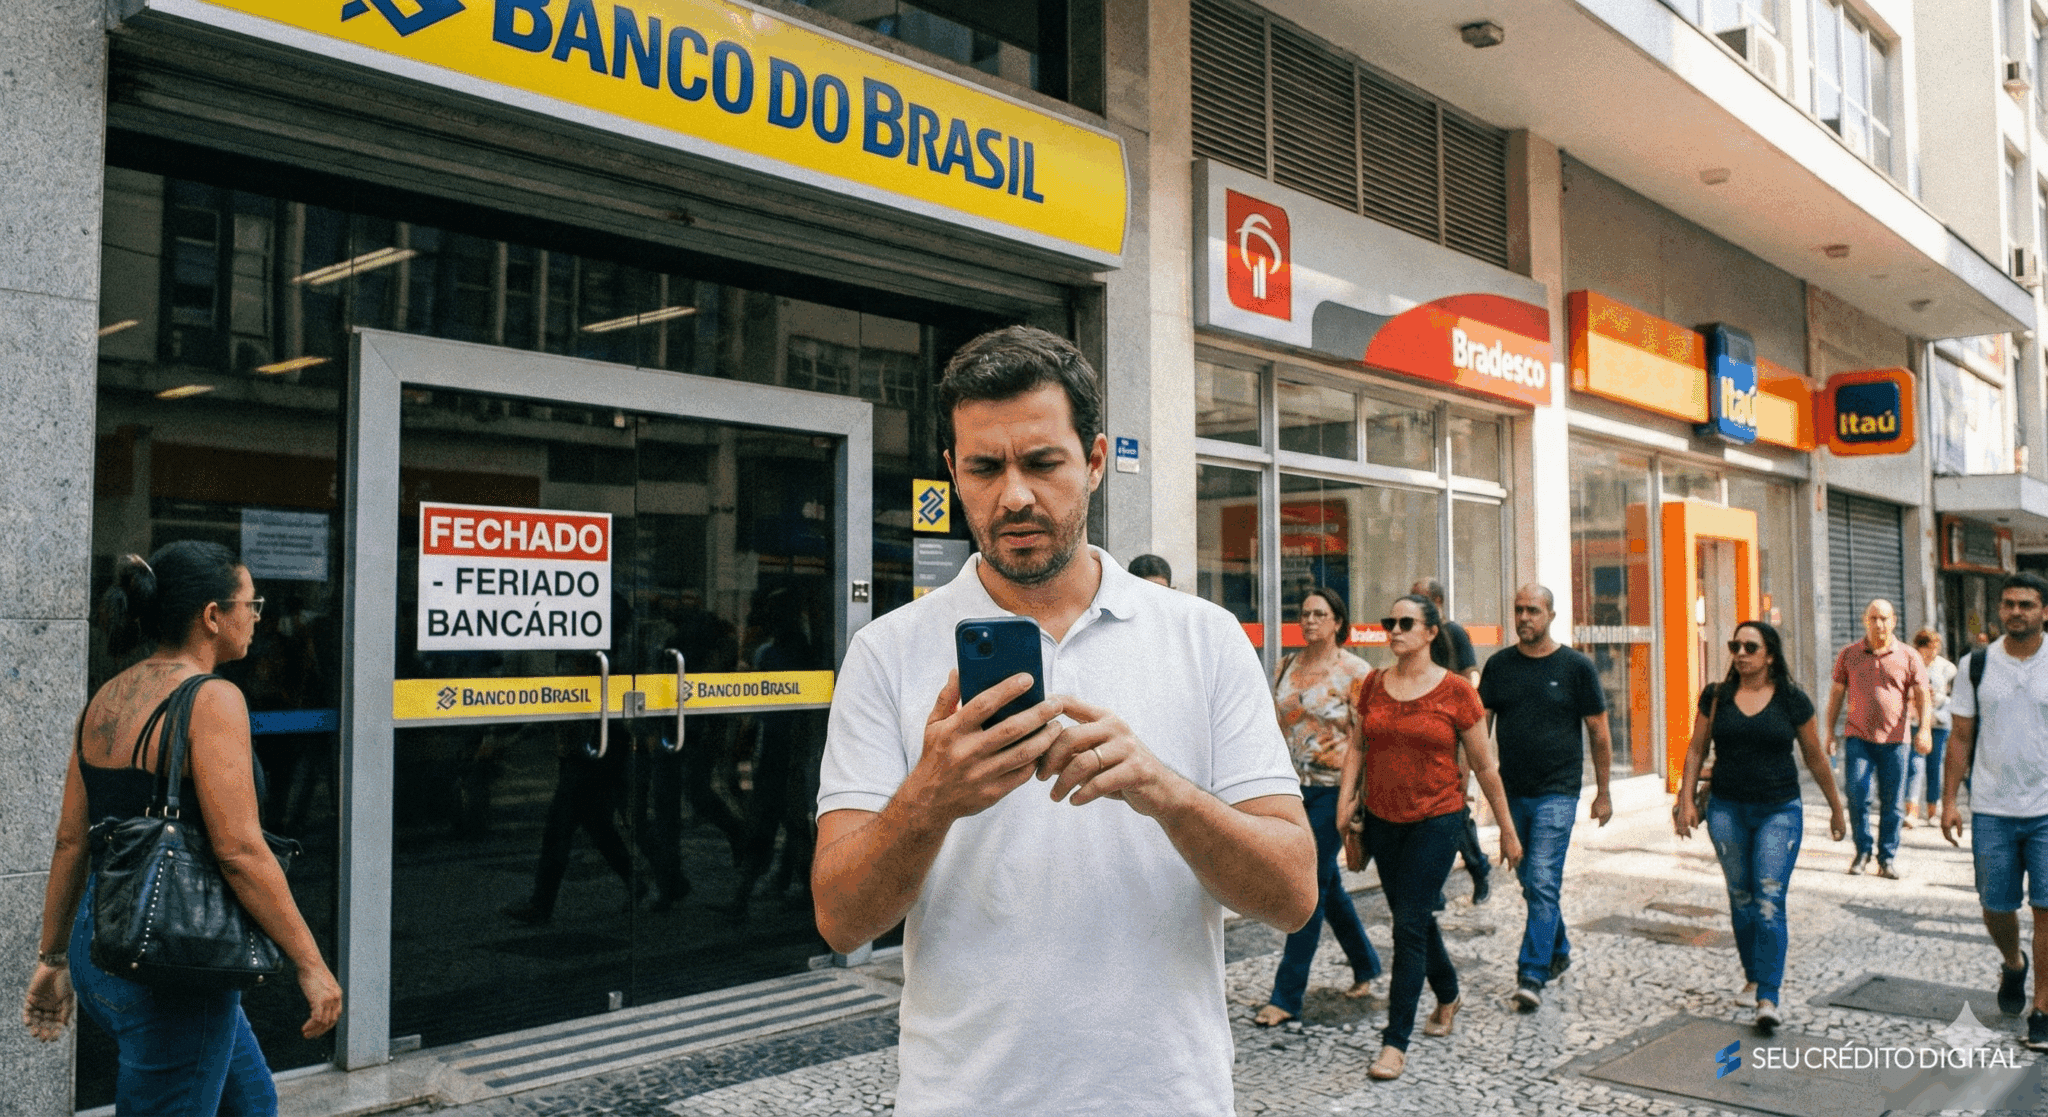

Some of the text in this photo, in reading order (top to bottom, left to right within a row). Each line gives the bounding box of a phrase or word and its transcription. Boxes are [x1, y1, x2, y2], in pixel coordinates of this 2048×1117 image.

[493, 0, 1045, 203] BANCO DO BRASIL
[1452, 327, 1546, 389] Bradesco
[1720, 375, 1757, 427] Itaú
[1839, 409, 1895, 436] Itaú
[430, 515, 603, 554] FECHADO
[456, 567, 599, 597] FERIADO
[428, 601, 602, 637] BANCÁRIO
[462, 686, 591, 706] BANCO DO BRASIL
[697, 680, 800, 698] BANCO DO BRASIL
